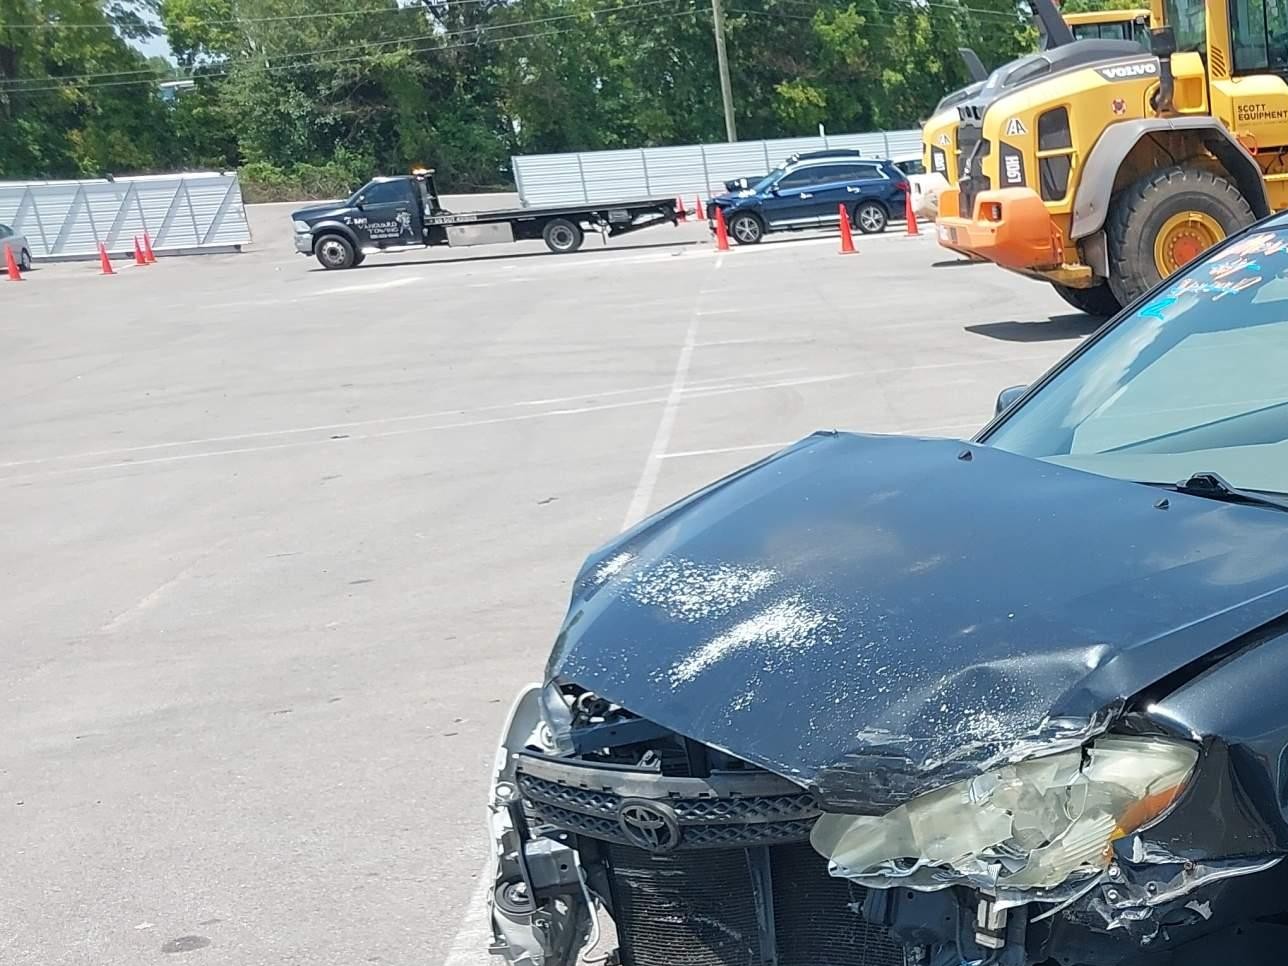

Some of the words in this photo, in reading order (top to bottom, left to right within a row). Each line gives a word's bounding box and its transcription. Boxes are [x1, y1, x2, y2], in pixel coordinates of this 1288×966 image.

[1102, 63, 1156, 78] VOLVO
[1238, 104, 1266, 113] SCOTT
[1238, 110, 1288, 121] EQUIPMENT
[1005, 156, 1021, 183] L90H
